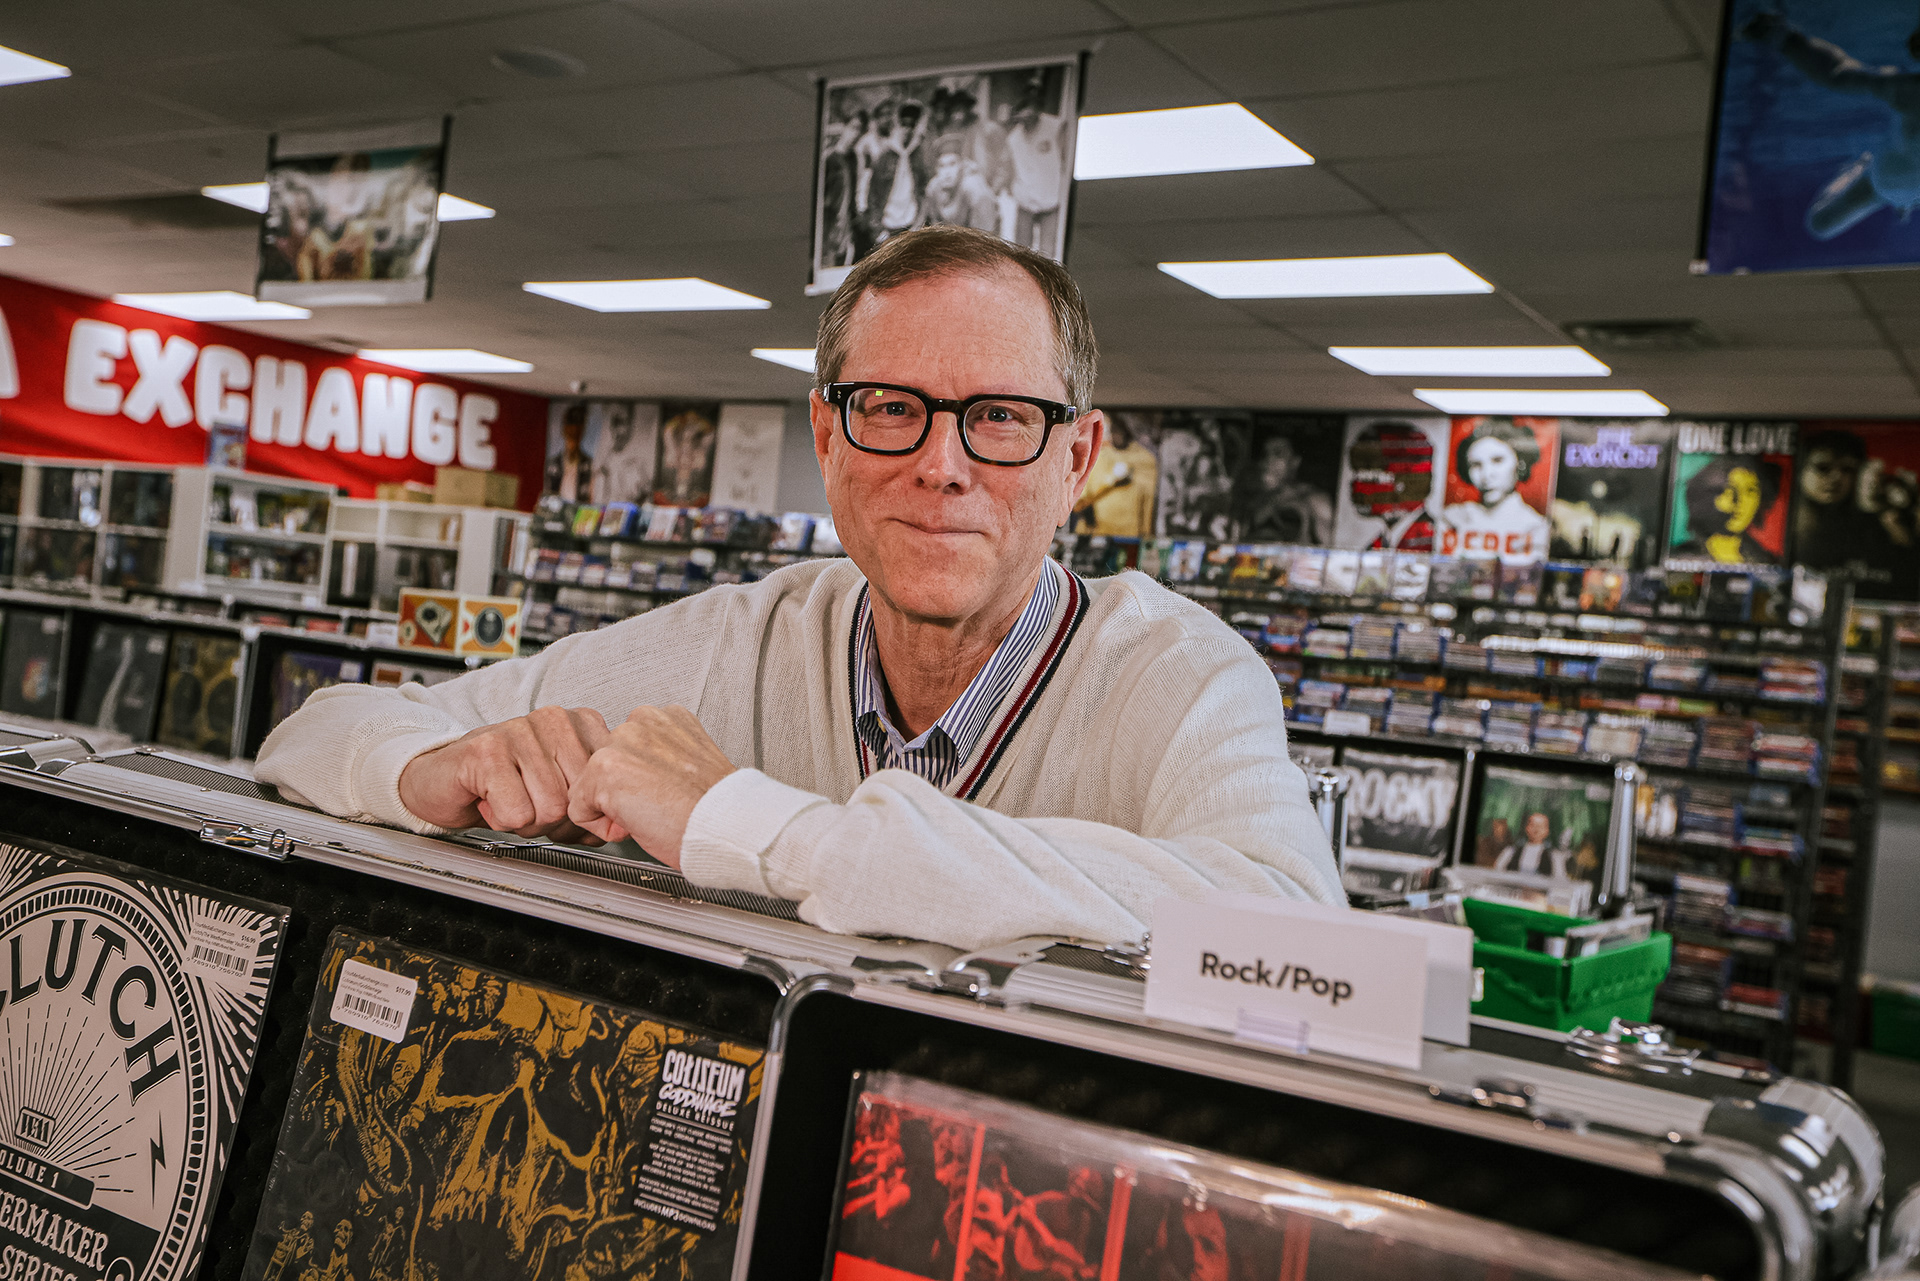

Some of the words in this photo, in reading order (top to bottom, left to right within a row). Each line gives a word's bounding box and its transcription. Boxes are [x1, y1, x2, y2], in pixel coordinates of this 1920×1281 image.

[64, 317, 499, 470] EXCHANGE
[1678, 423, 1724, 453] ONE
[1731, 423, 1793, 454] LOVE
[241, 935, 256, 944] $16.99
[395, 986, 412, 997] $17.99
[1201, 952, 1353, 1006] Rock/Pop
[0, 919, 181, 1107] LUTCH
[662, 1049, 746, 1103] COLISEUM
[656, 1101, 691, 1119] DELUXE
[695, 1111, 735, 1132] REISSUE
[51, 1172, 59, 1189] 1
[0, 1189, 108, 1271] ERMAKER
[661, 1205, 679, 1221] MP3
[679, 1212, 716, 1232] DOWNLOAD
[0, 1245, 78, 1281] SERI
